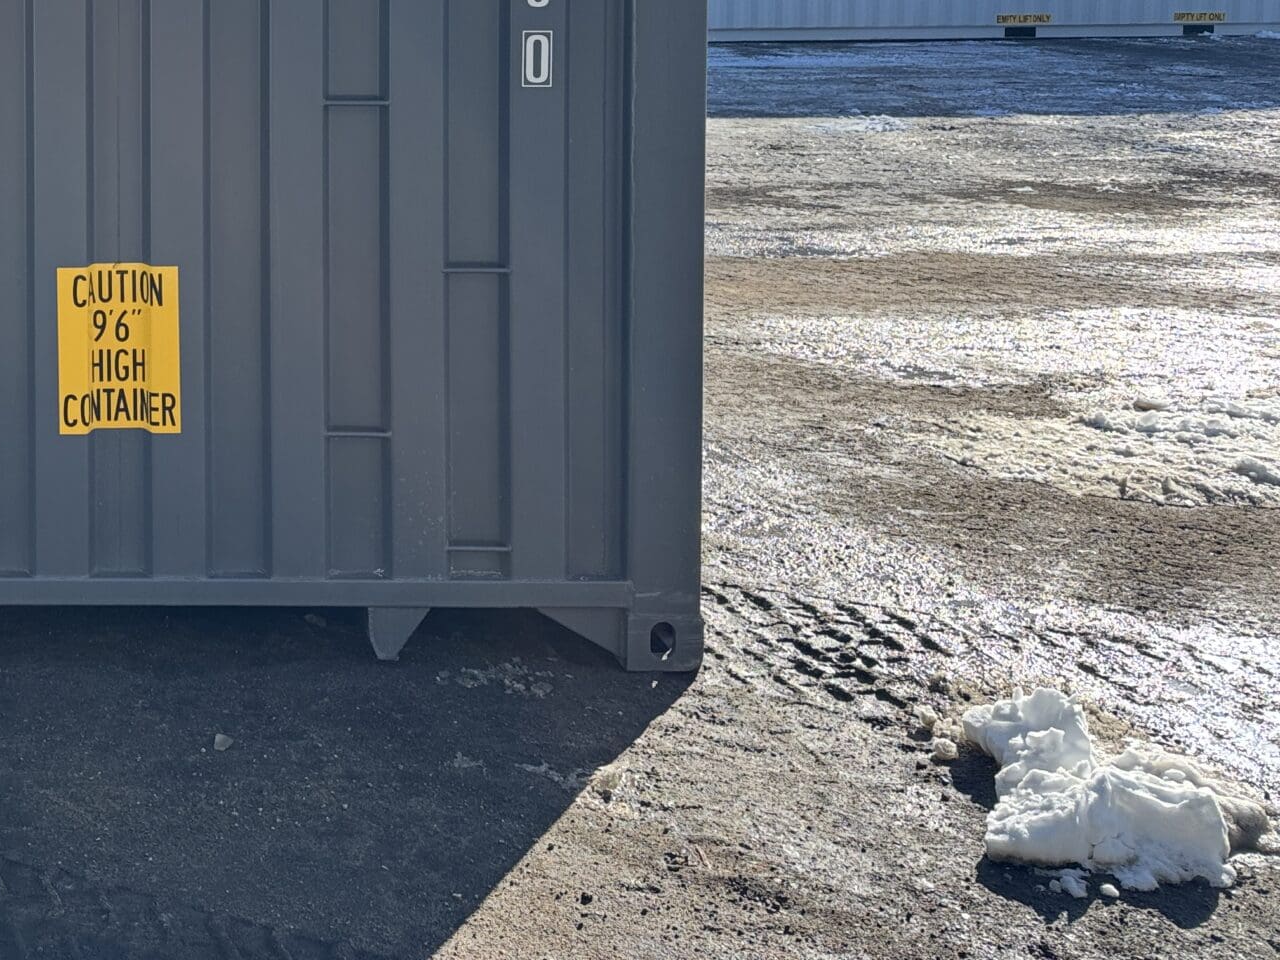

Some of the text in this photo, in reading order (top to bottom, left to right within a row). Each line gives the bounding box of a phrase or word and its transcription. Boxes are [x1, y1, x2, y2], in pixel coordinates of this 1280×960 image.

[524, 33, 551, 84] 0
[72, 269, 163, 308] CAUTION
[92, 309, 142, 343] 9'6"
[91, 348, 146, 383] HIGH
[63, 387, 177, 428] CONTAINER
